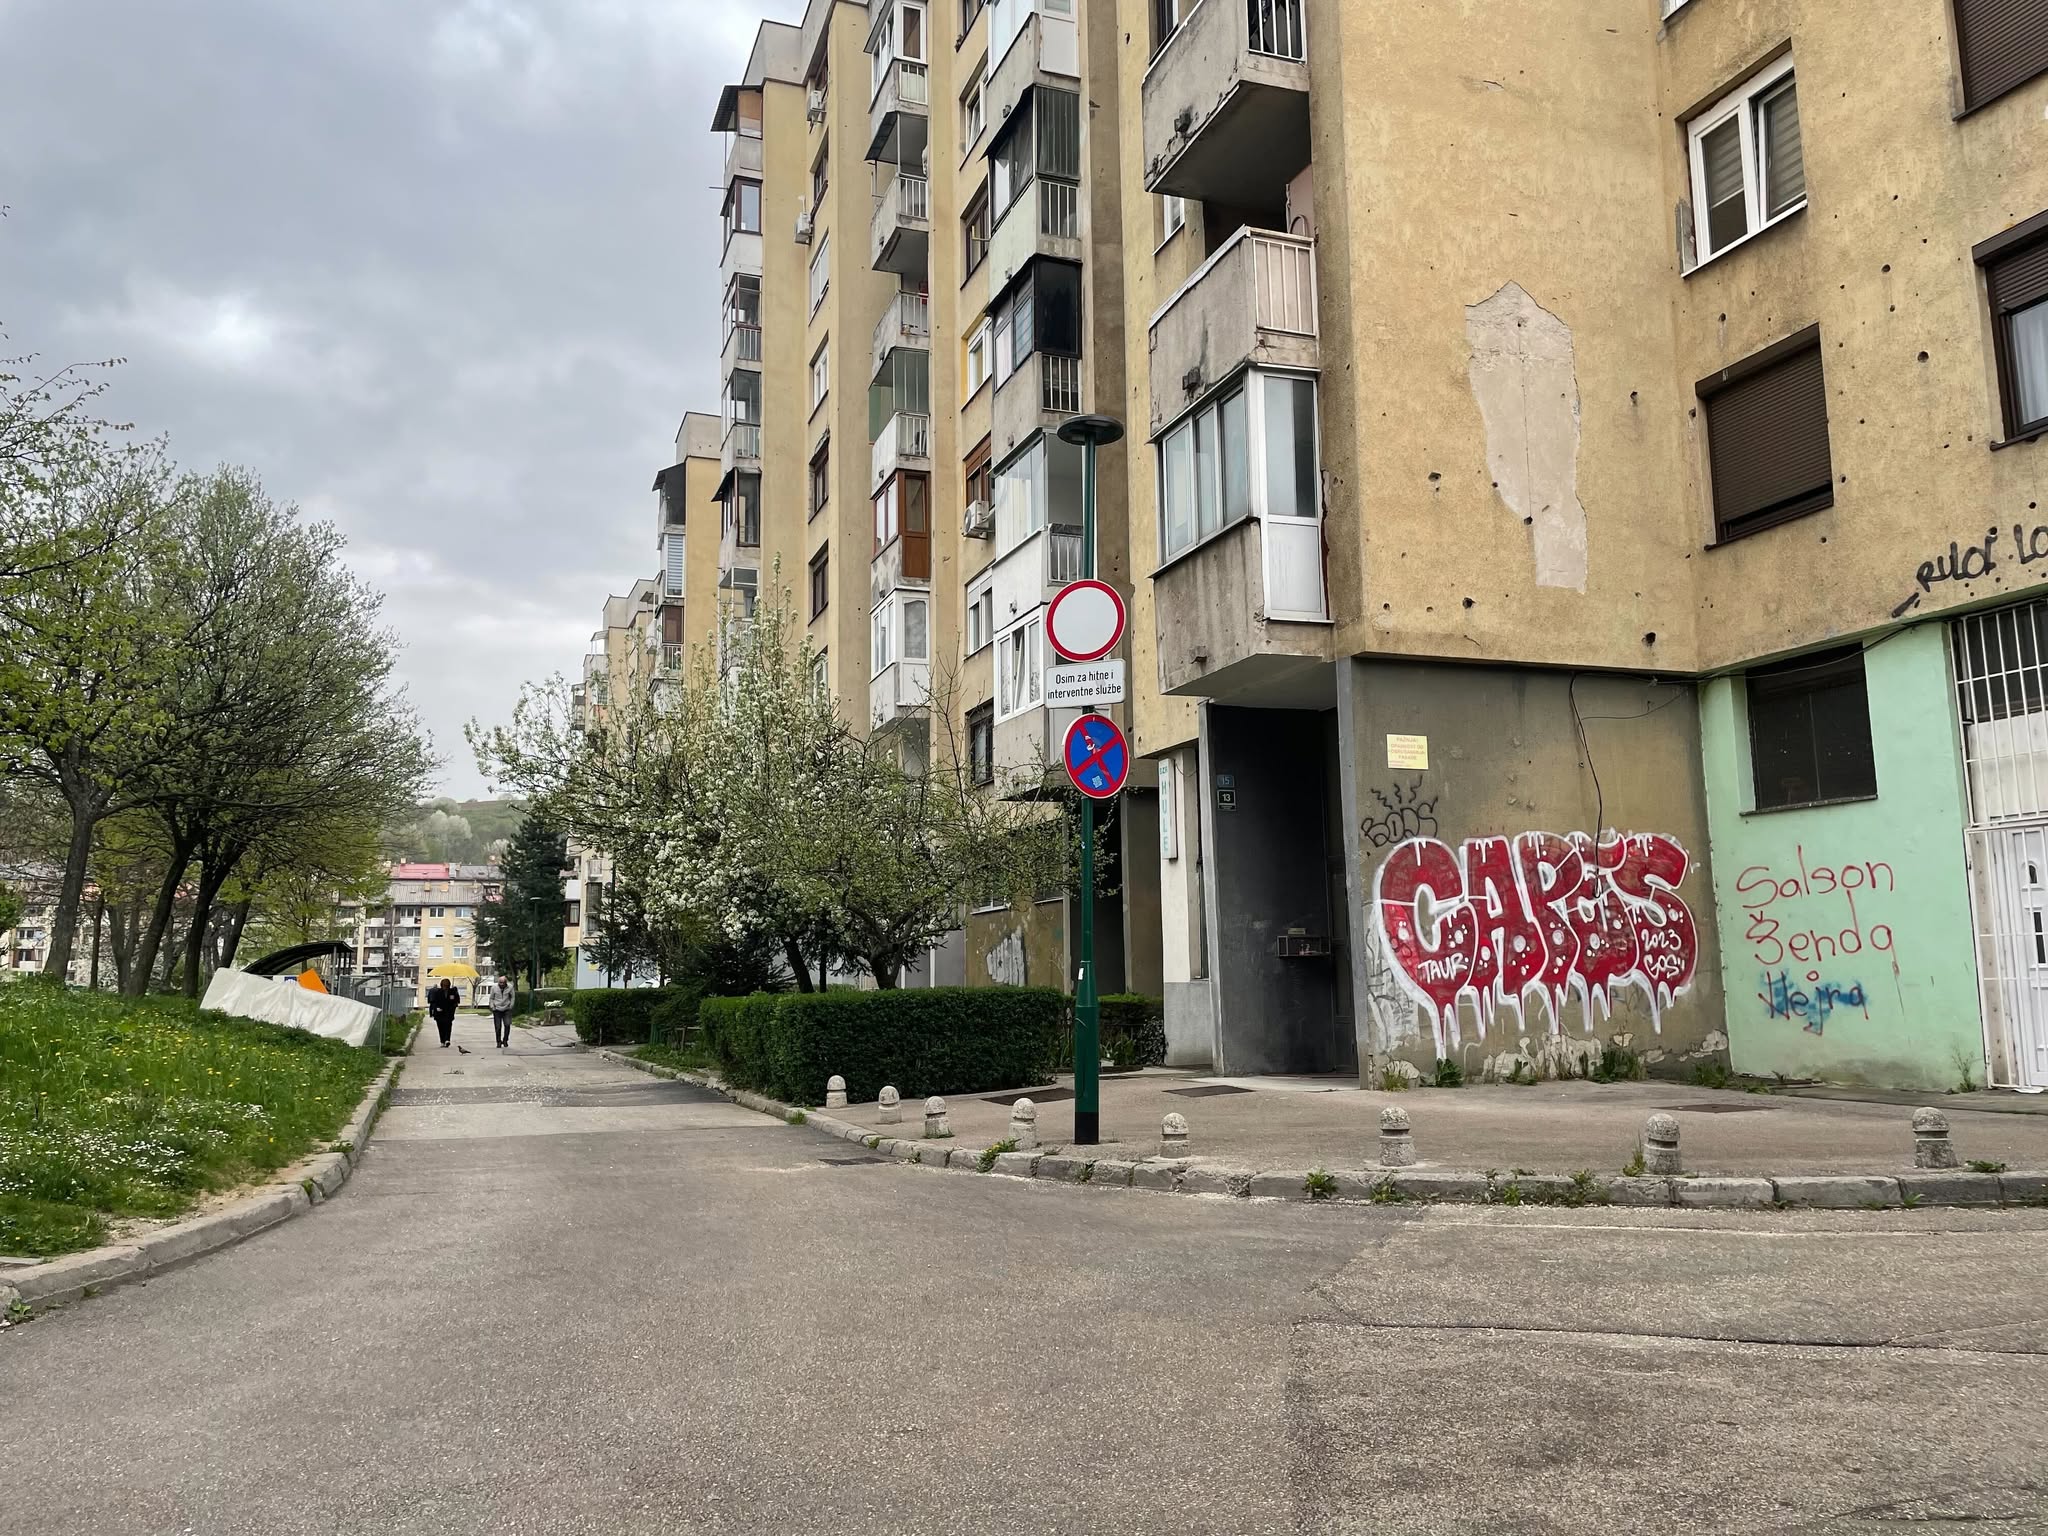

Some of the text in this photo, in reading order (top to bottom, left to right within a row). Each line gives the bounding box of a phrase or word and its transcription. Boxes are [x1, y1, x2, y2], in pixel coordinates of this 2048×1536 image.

[1055, 669, 1114, 684] Osim za hitne i
[1047, 683, 1122, 700] interventne službe
[1221, 793, 1231, 802] 13
[1641, 929, 1683, 951] 2023
